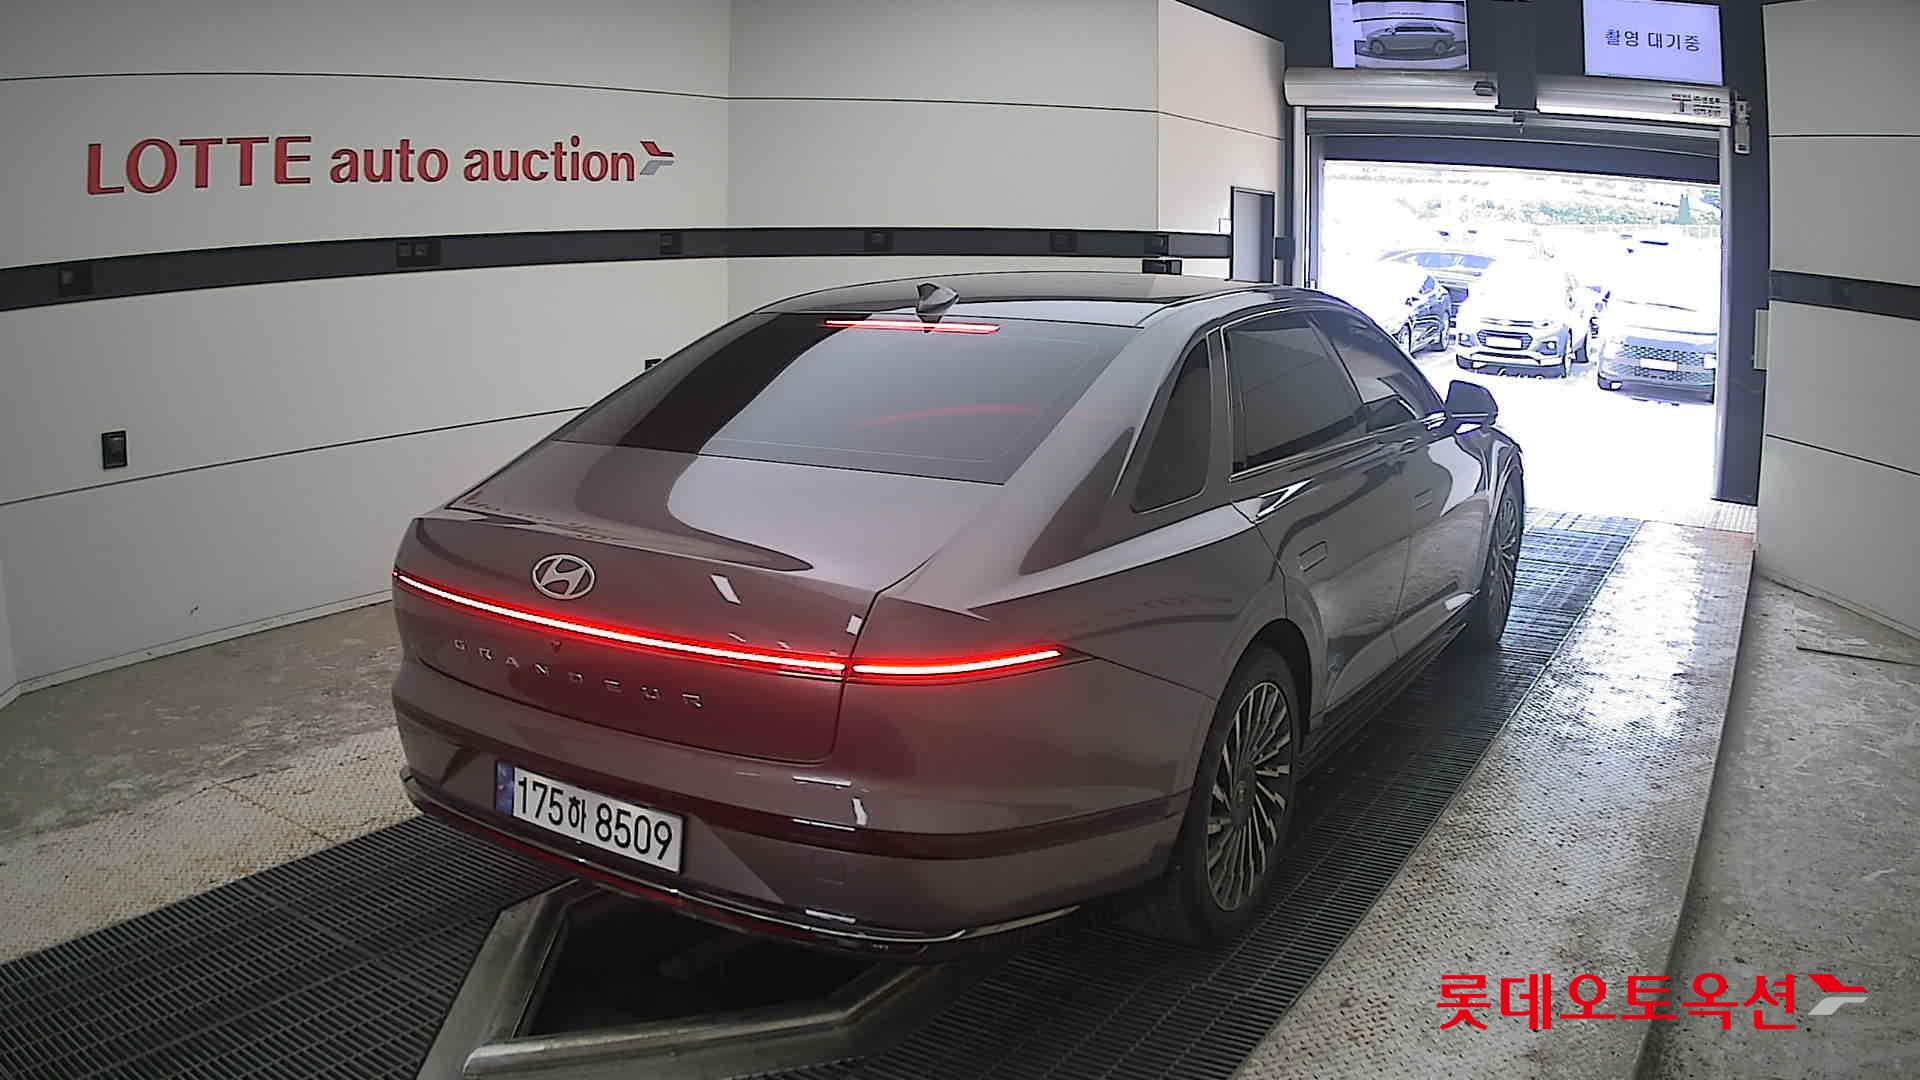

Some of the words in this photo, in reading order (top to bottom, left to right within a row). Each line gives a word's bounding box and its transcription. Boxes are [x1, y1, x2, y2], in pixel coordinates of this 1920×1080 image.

[86, 135, 312, 195] LOTTE
[329, 138, 448, 184] auto
[463, 135, 636, 183] auction
[518, 777, 587, 834] 175하
[595, 803, 673, 860] 8509
